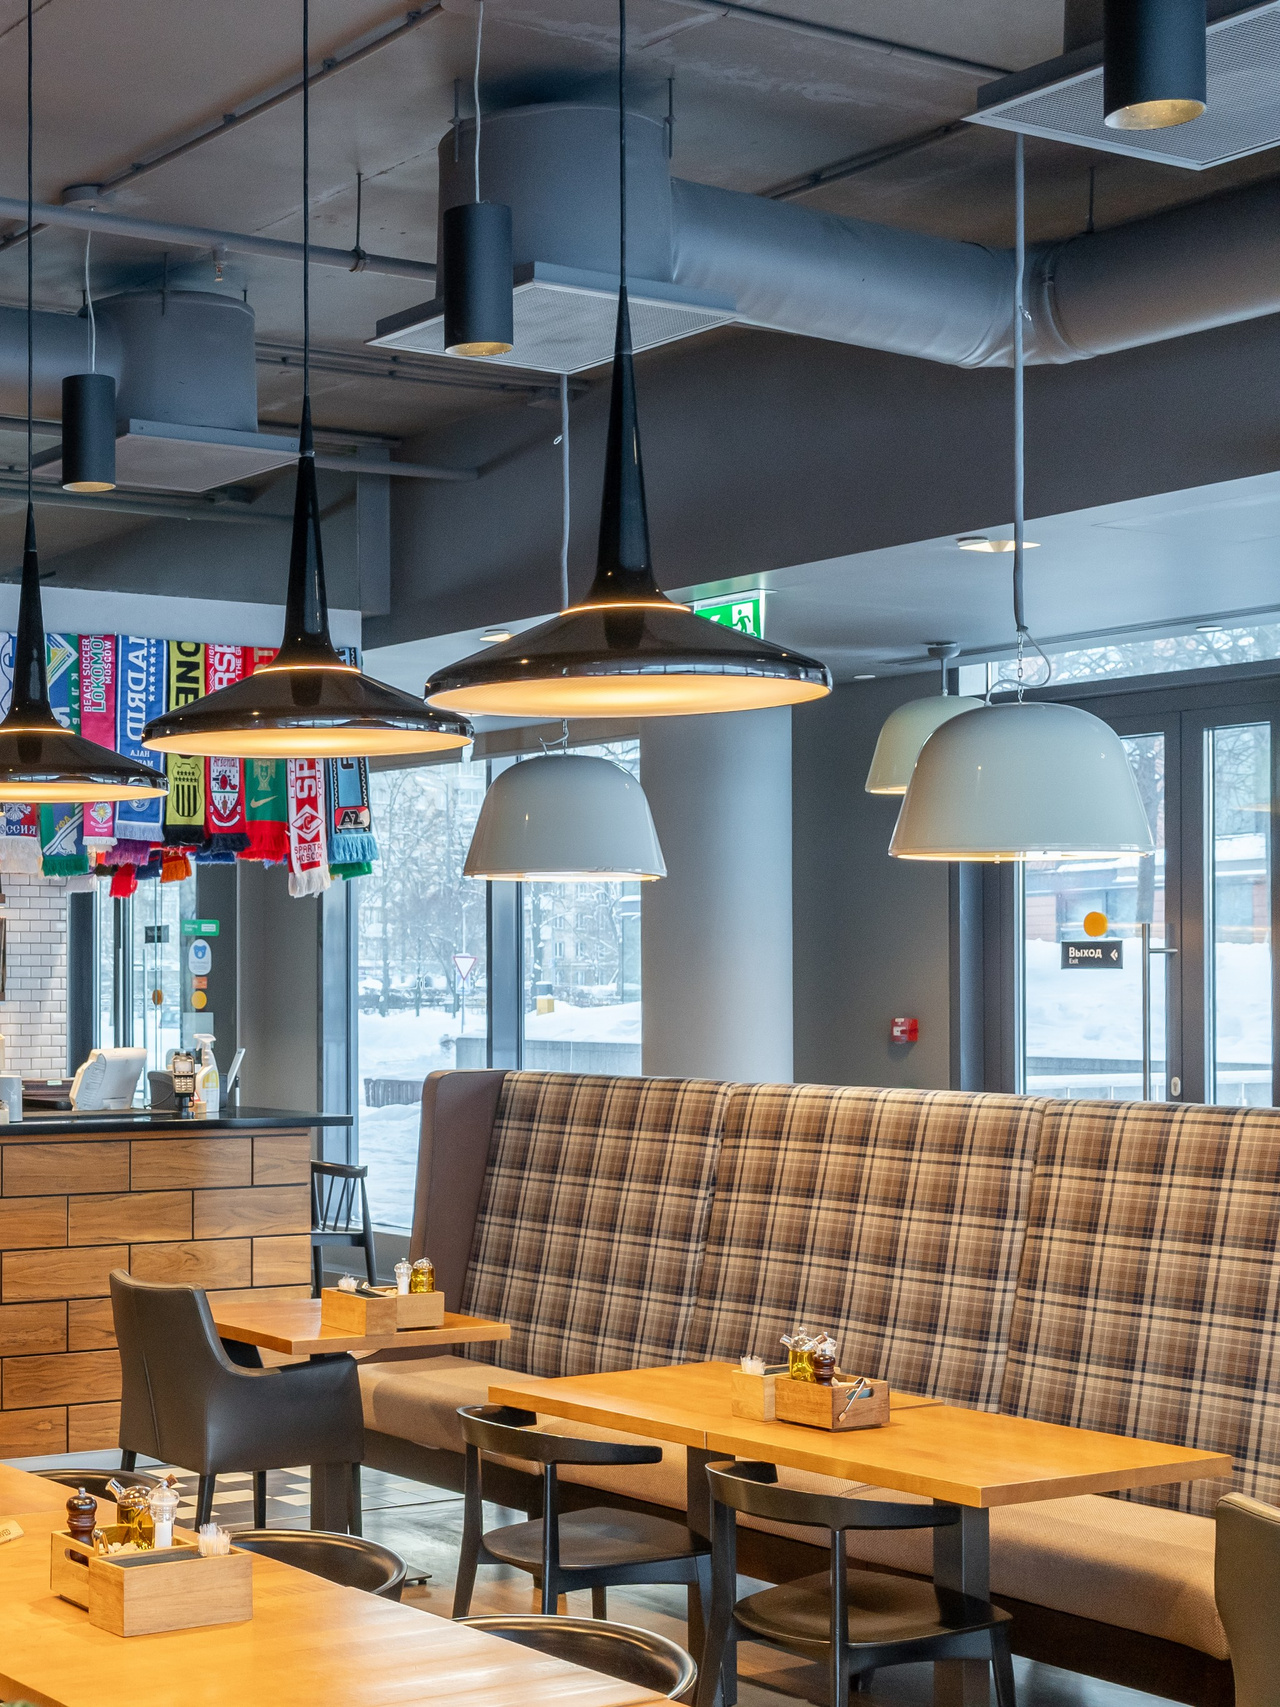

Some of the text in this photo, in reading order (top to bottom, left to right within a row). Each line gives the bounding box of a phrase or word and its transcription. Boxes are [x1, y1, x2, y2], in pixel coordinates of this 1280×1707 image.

[82, 638, 92, 712] BEACH SOCCER
[104, 640, 112, 684] MOSCOW
[340, 810, 364, 827] AZ
[1068, 946, 1103, 959] Выход
